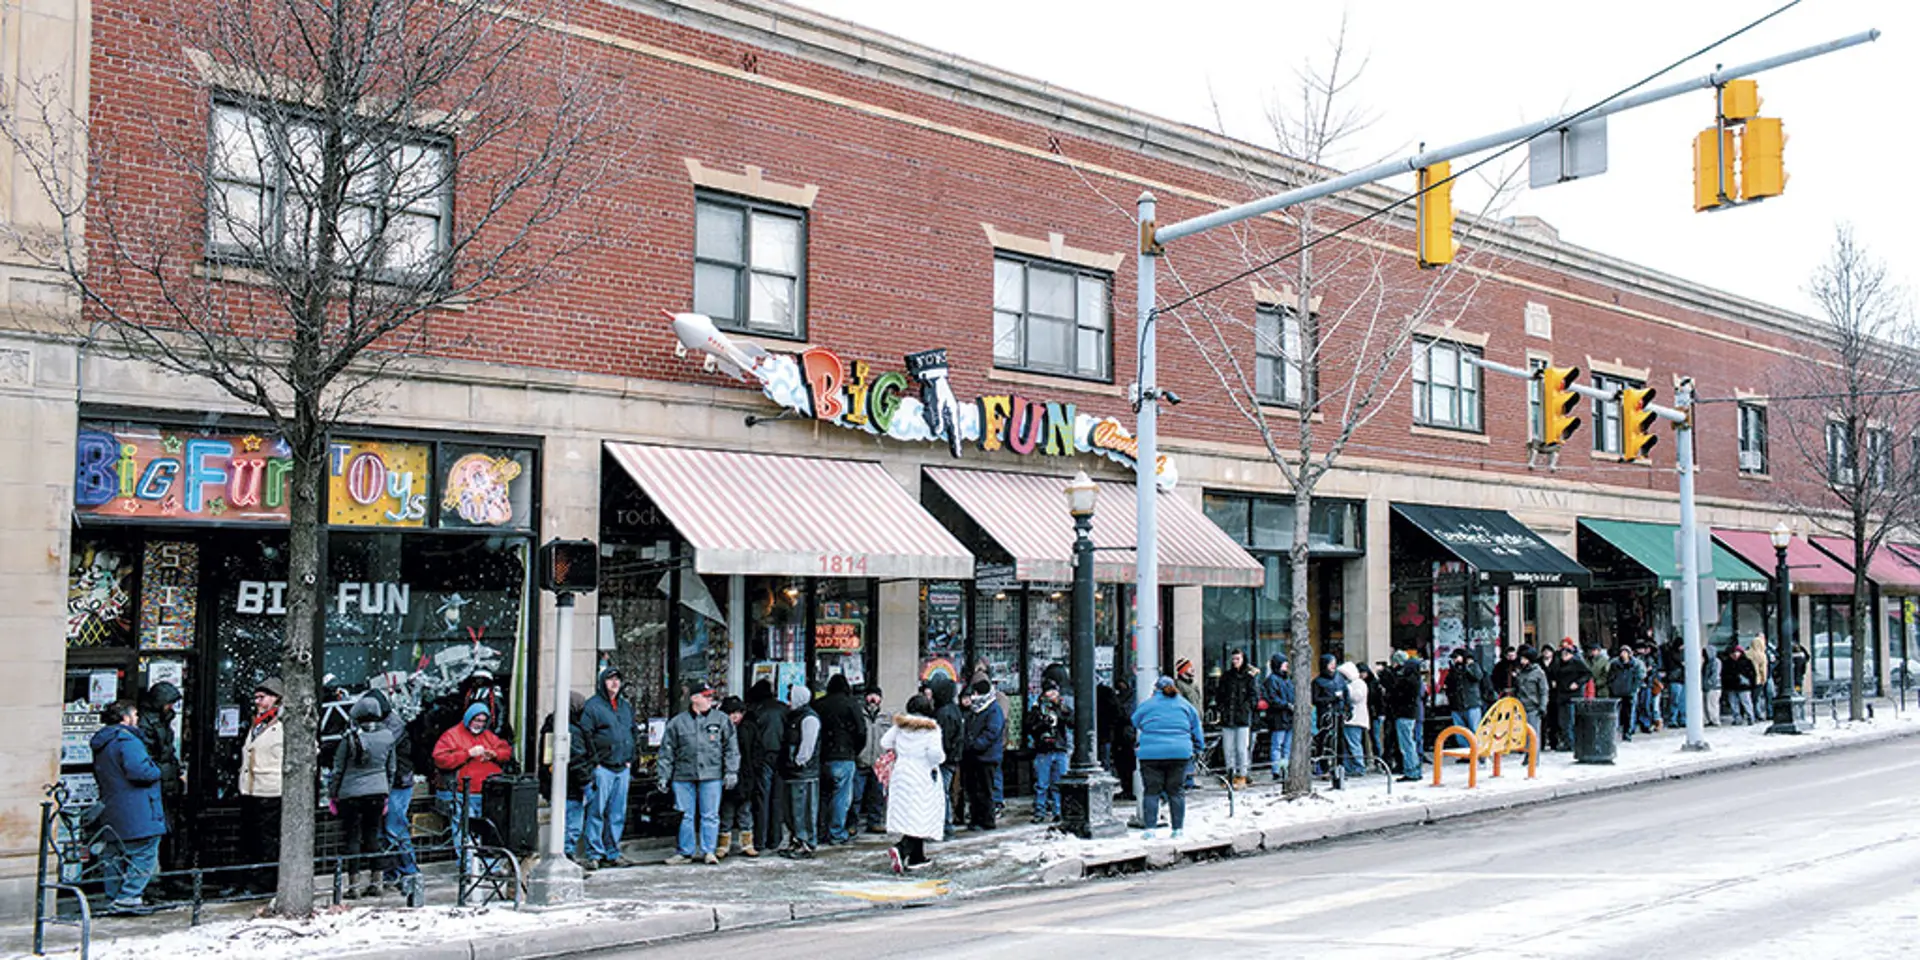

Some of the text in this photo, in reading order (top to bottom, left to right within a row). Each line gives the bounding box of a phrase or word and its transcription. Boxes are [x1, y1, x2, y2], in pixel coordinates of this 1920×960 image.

[979, 394, 1076, 456] FUN
[819, 555, 868, 576] 1814
[157, 545, 184, 649] SMILE
[236, 580, 410, 616] BI FUN
[834, 624, 856, 636] BUY
